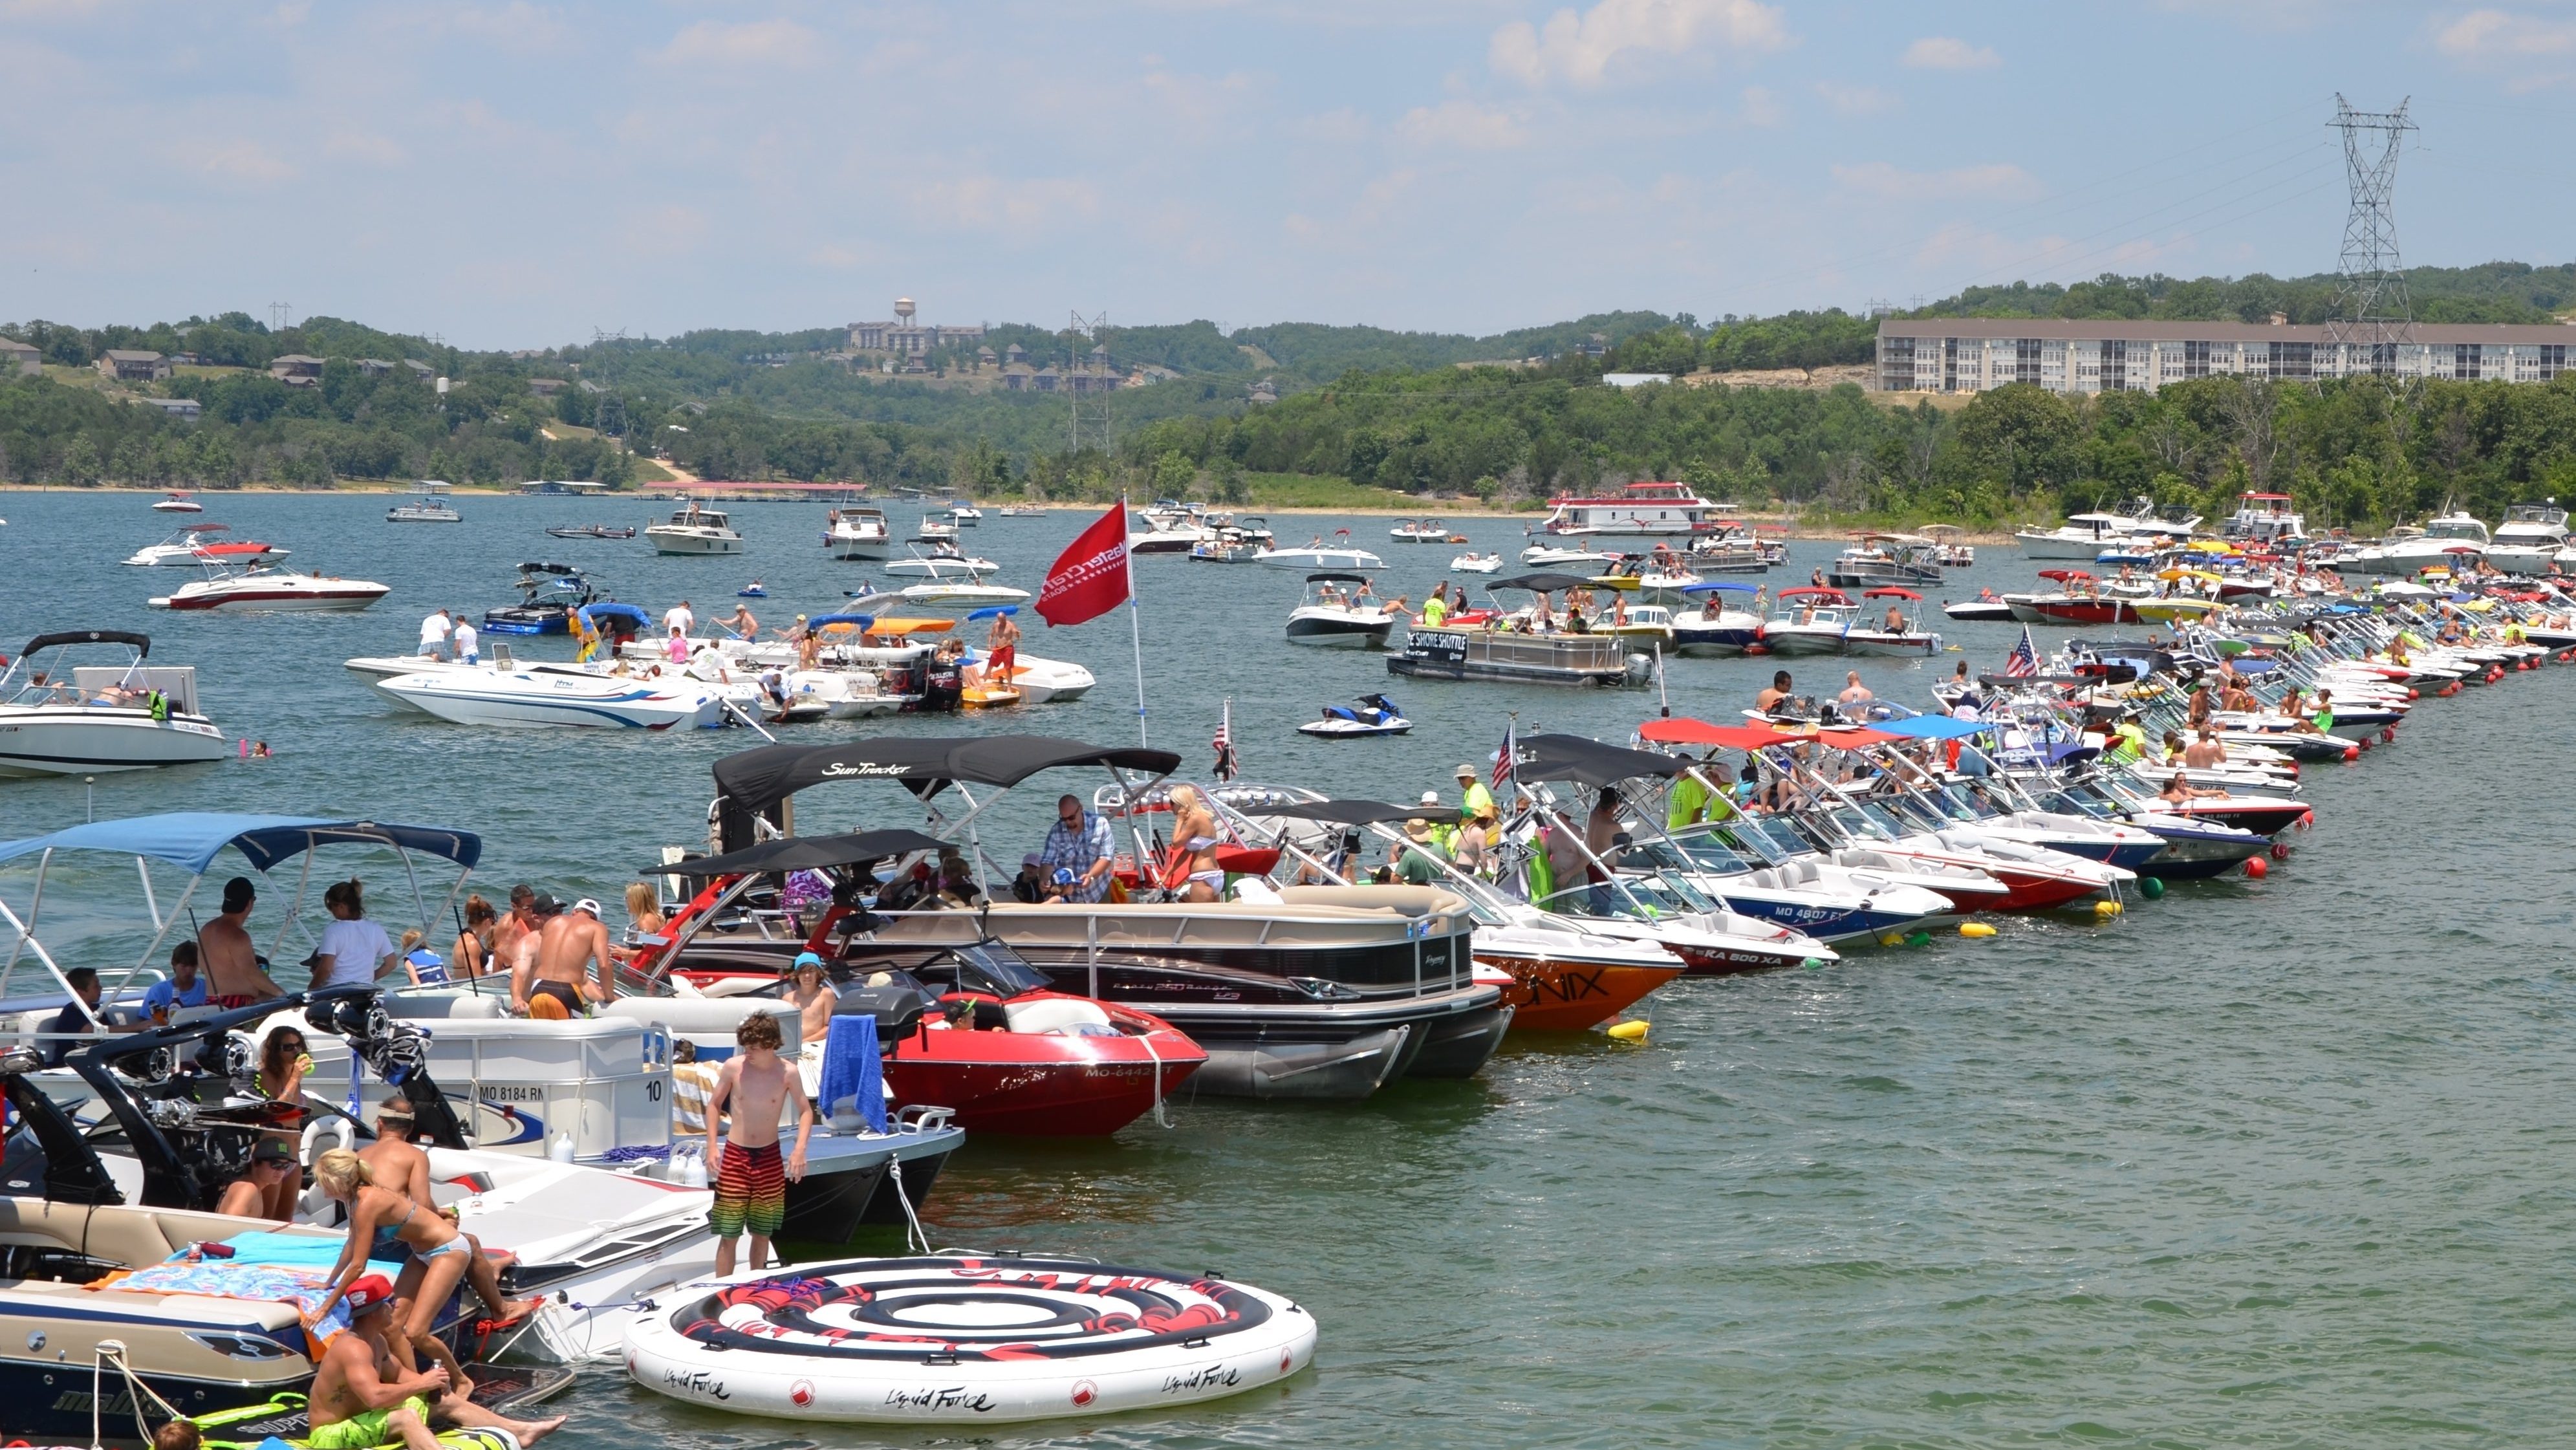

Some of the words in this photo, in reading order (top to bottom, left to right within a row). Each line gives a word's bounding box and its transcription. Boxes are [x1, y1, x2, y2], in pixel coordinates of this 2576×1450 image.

[1415, 632, 1438, 647] SHORE
[1439, 634, 1466, 650] SHUTTLE
[1775, 907, 1793, 916] MO
[1797, 909, 1826, 918] 4807
[1704, 949, 1726, 960] KA
[1729, 953, 1759, 962] 500
[1085, 1066, 1174, 1077] MO-6442-T
[479, 1087, 496, 1100] MO
[501, 1087, 526, 1100] 8184
[646, 1081, 661, 1102] 10
[664, 1369, 692, 1388] Liquid
[691, 1371, 731, 1400] Force
[1162, 1370, 1202, 1394] Liquid
[1197, 1363, 1242, 1392] Force
[885, 1387, 935, 1409] Liquid
[932, 1386, 997, 1412] Force
